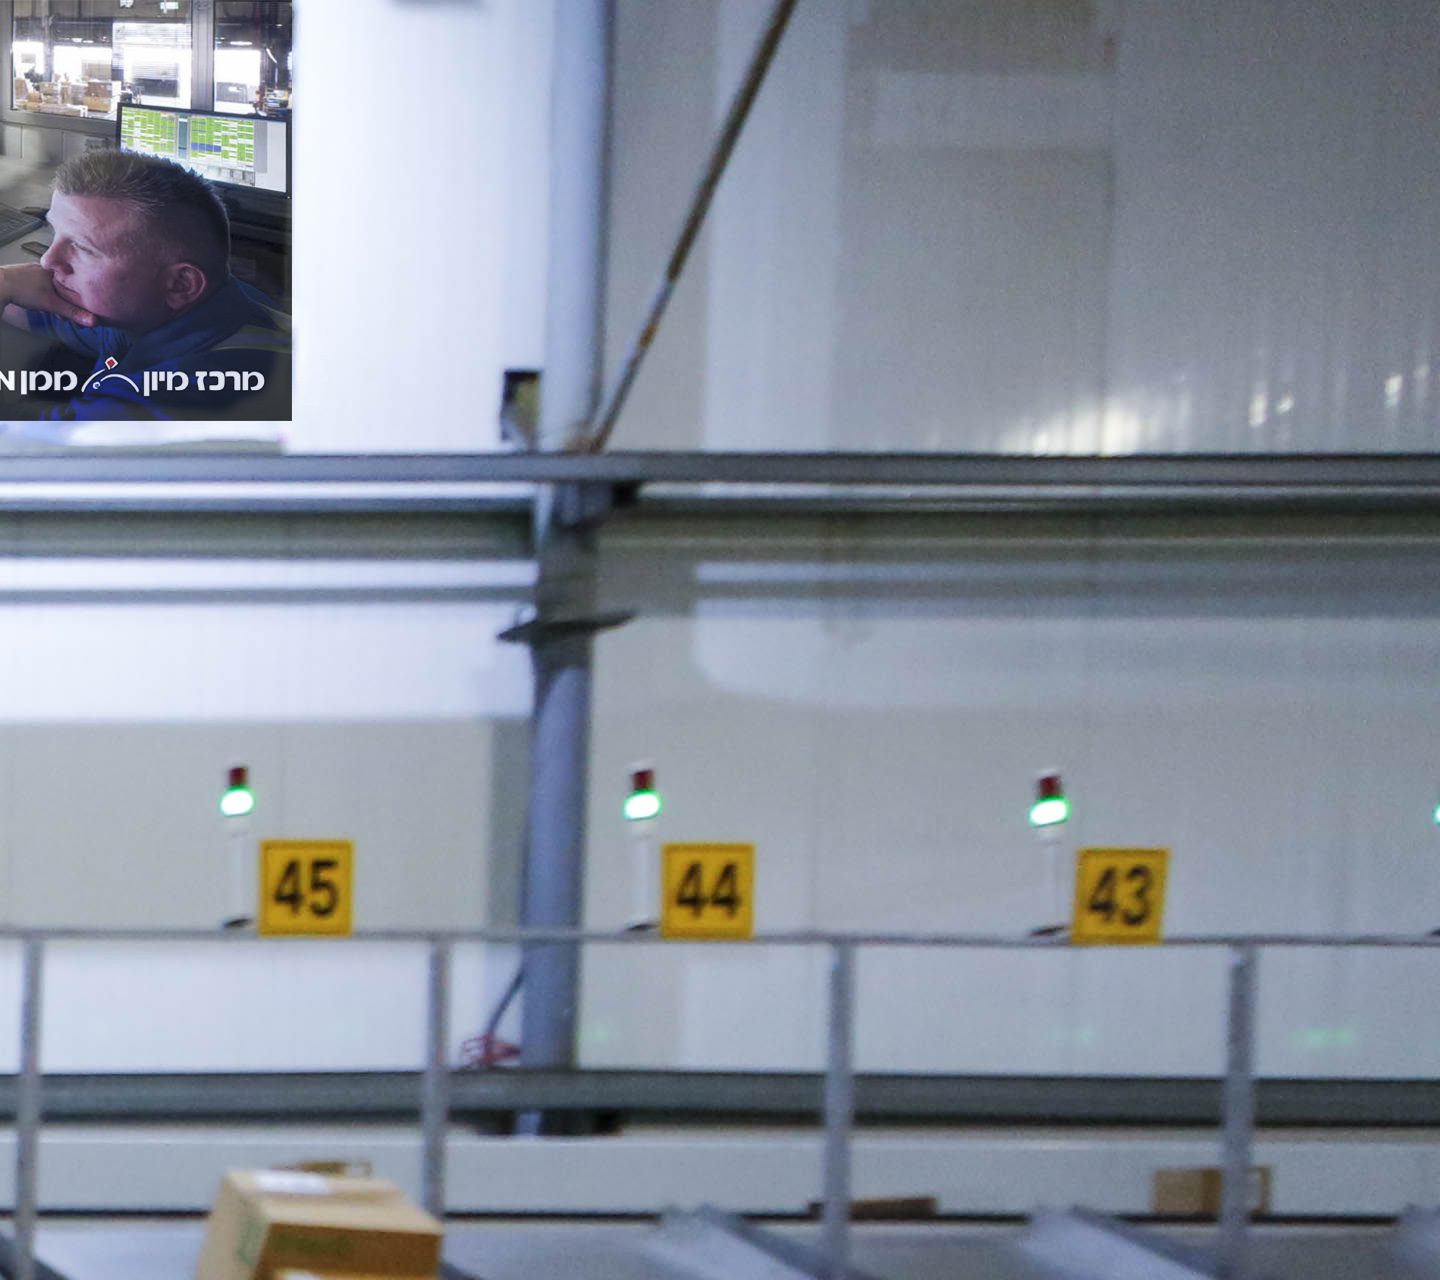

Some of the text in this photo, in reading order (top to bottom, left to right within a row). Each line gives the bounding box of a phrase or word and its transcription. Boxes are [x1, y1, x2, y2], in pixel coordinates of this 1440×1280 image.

[20, 370, 78, 395] ממן
[143, 370, 190, 397] מיון
[195, 370, 266, 392] מרכז
[271, 857, 339, 919] 45
[673, 860, 742, 919] 44
[1086, 864, 1152, 925] 43
